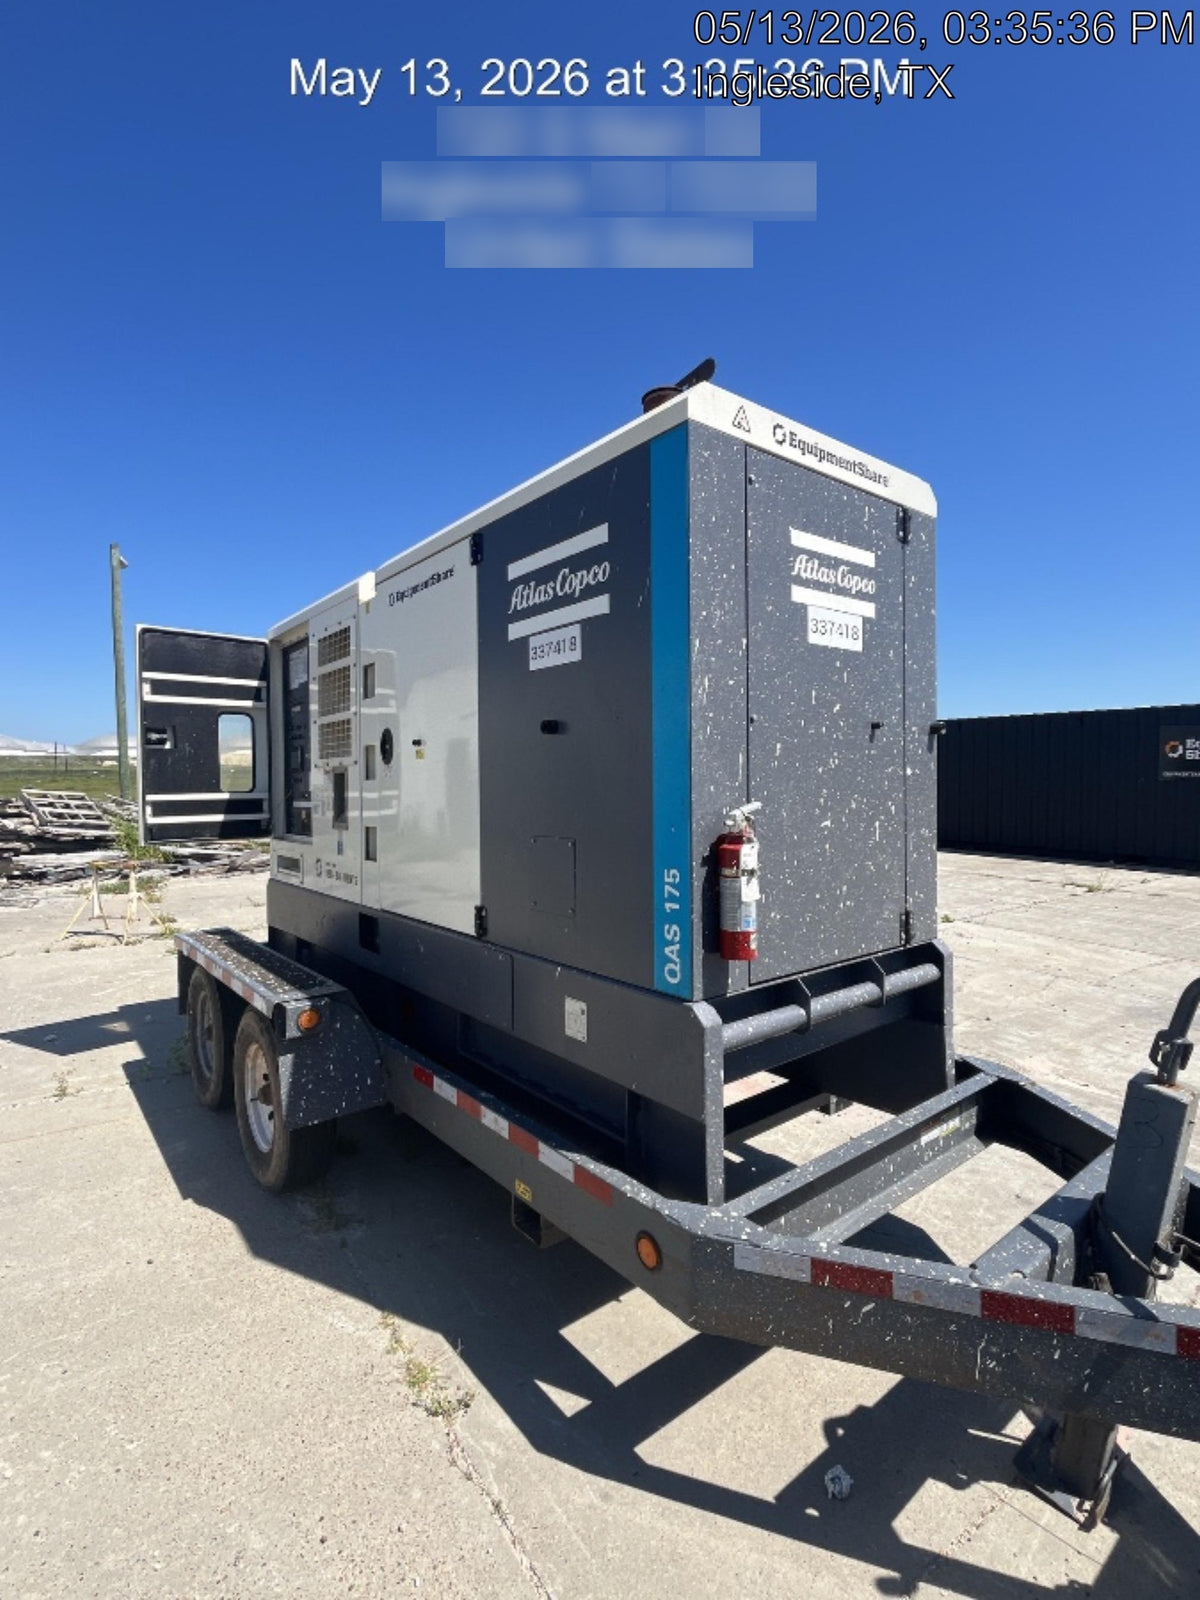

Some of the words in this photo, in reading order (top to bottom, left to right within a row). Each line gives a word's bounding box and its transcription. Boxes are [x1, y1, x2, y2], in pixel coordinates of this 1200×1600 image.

[788, 430, 890, 488] EquipmentShare
[530, 635, 578, 661] 337418
[810, 617, 860, 642] 337418
[664, 868, 680, 913] 175
[664, 924, 681, 984] QAS
